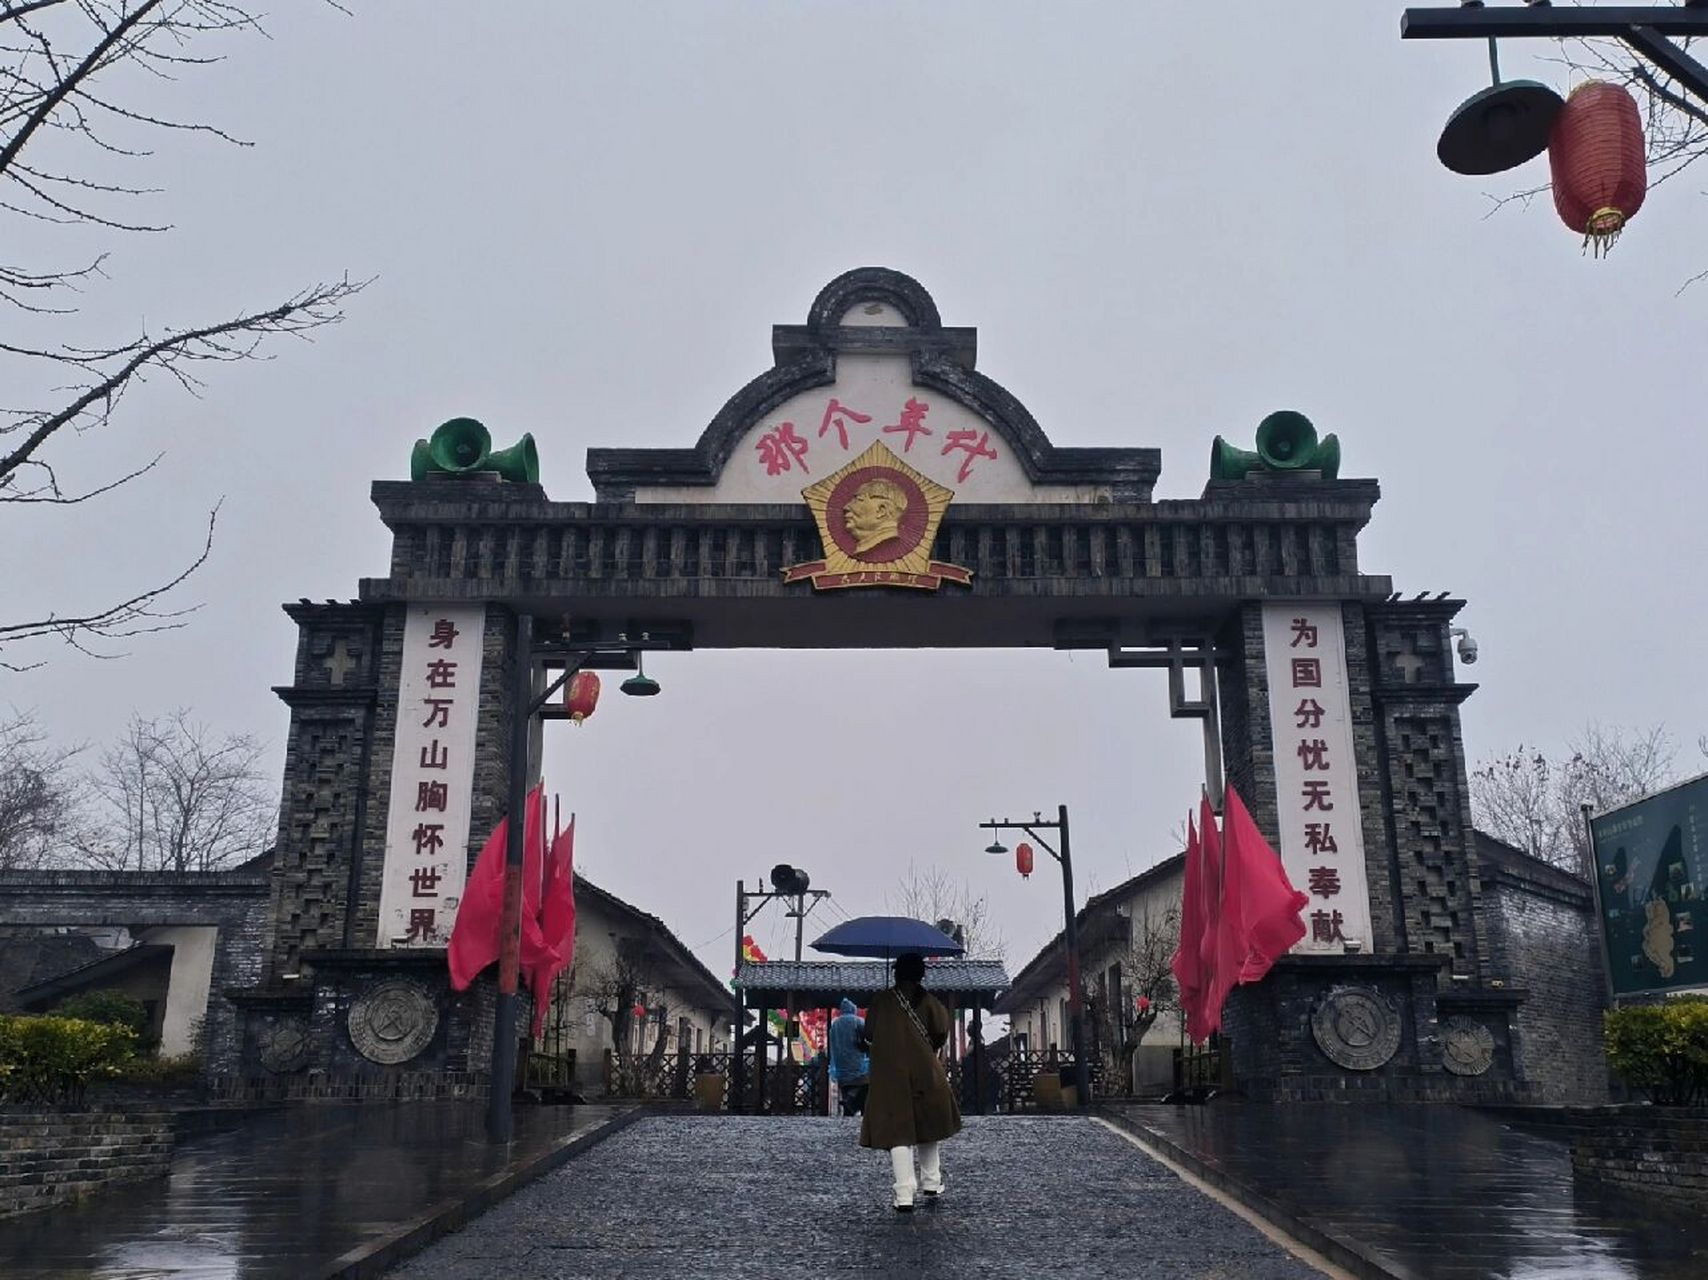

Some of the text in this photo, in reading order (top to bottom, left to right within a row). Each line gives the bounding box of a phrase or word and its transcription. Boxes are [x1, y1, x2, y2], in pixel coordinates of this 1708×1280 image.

[755, 396, 998, 484] 那个年代
[405, 618, 460, 942] 身在万山胸怀世界
[1289, 618, 1347, 943] 为国分忧无私奉献
